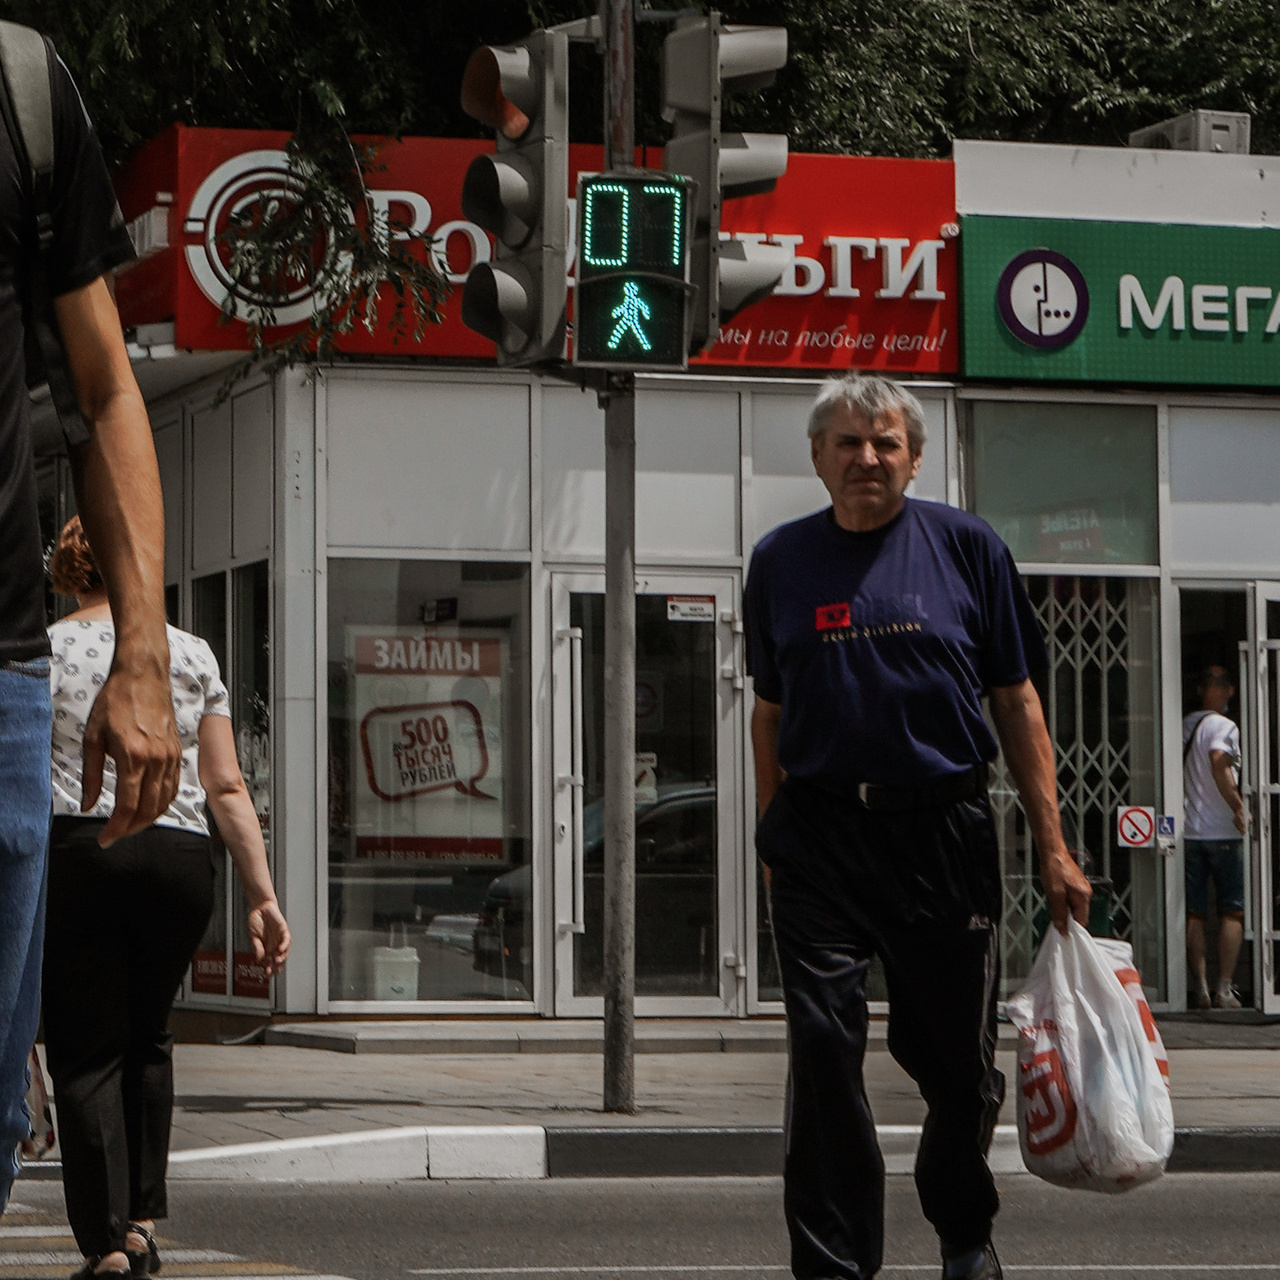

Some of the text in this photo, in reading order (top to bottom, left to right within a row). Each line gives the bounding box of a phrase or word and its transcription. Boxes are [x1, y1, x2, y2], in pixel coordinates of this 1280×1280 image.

[583, 183, 681, 267] 07
[759, 328, 788, 347] на
[795, 324, 875, 350] любые
[883, 328, 947, 353] цели!
[374, 636, 480, 671] ЗАЙМЫ
[400, 715, 449, 750] 500
[393, 743, 454, 770] ТЫСЯЧ
[400, 759, 458, 787] РУБЛЕЙ
